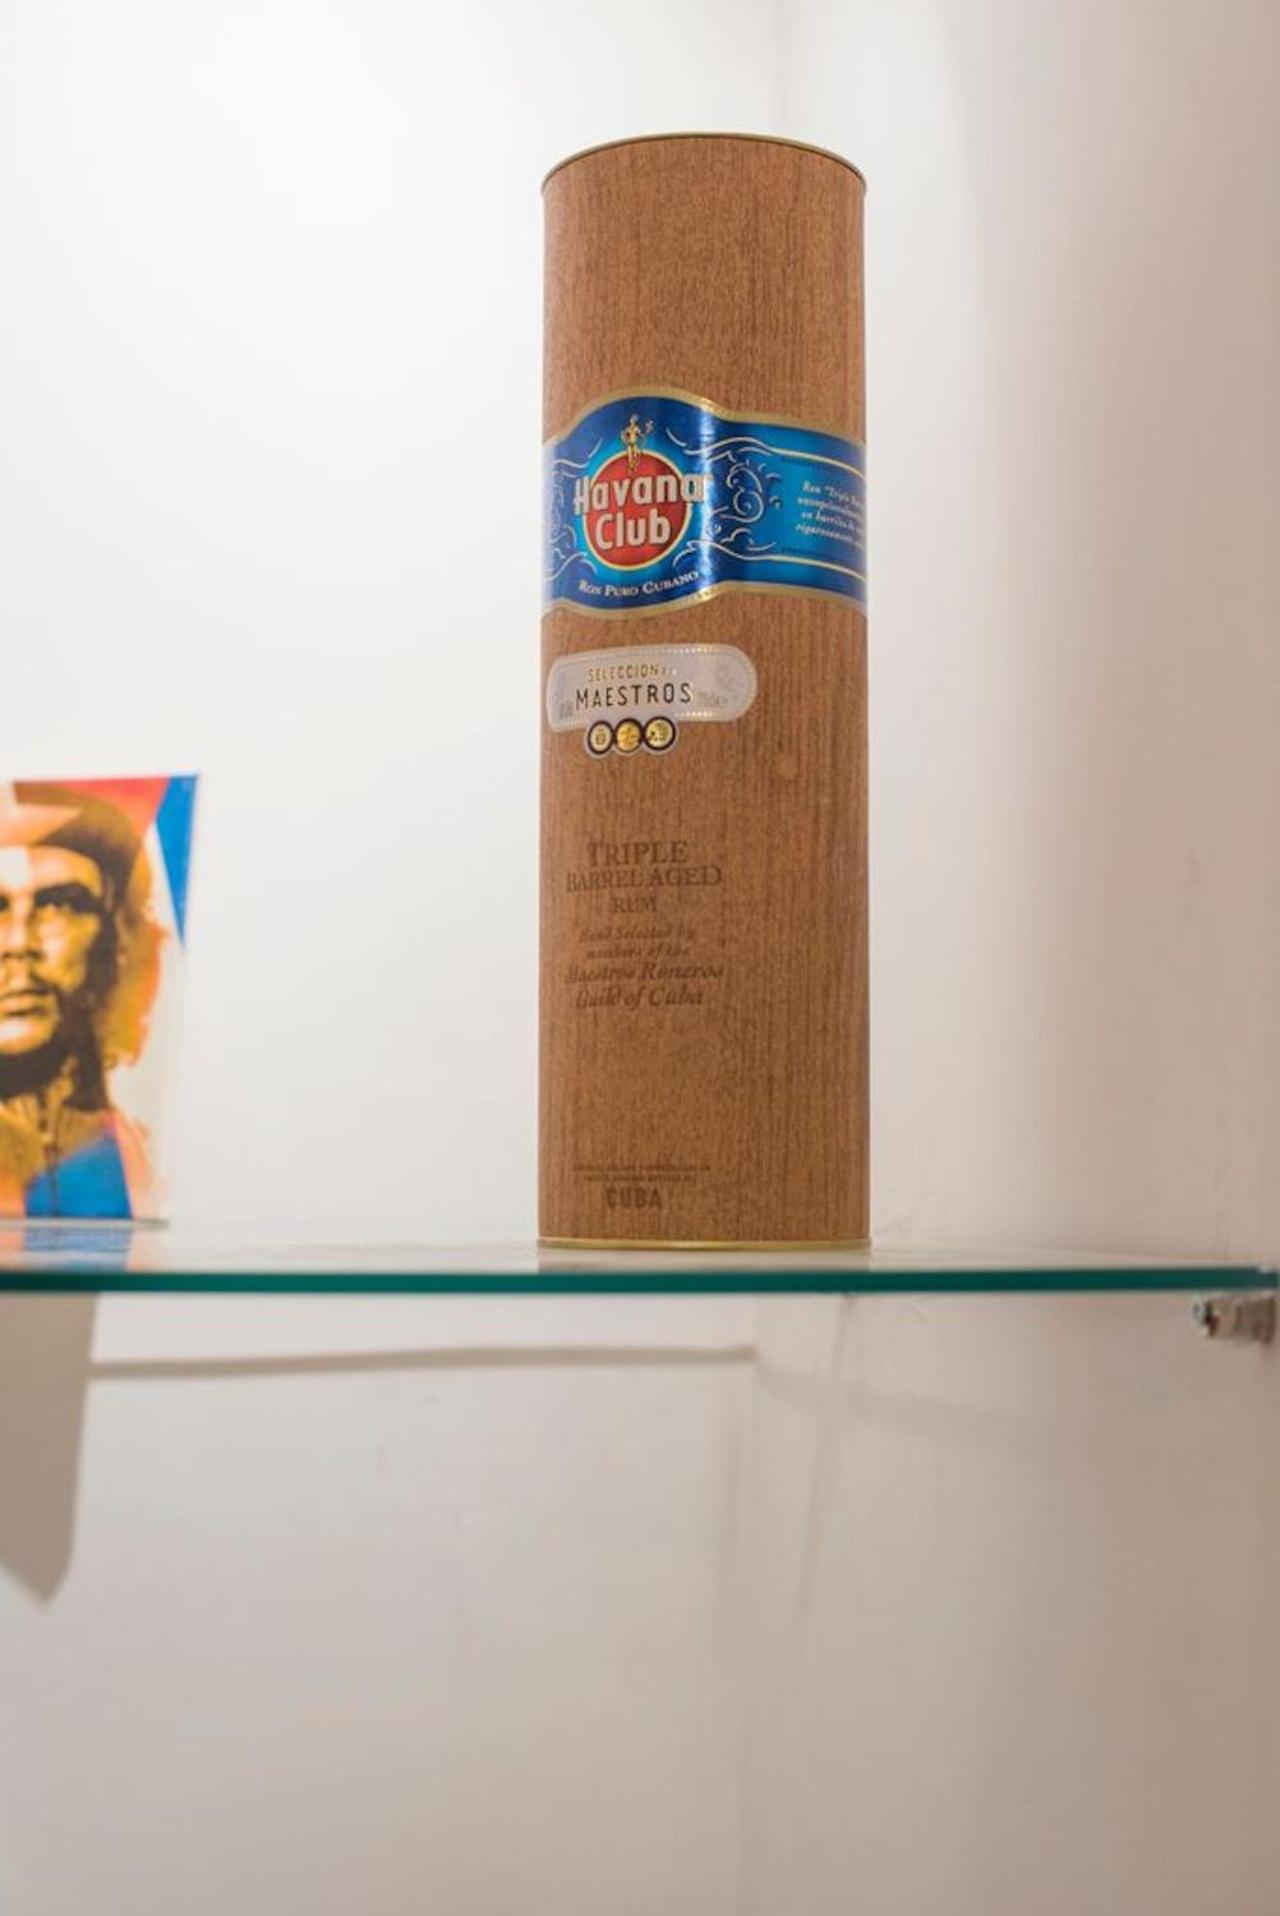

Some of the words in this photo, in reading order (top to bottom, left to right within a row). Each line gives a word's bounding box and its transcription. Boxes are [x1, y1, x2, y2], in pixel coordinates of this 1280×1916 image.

[573, 472, 712, 515] Havana
[595, 504, 672, 551] Club
[575, 682, 692, 711] MAESTROS
[586, 841, 690, 867] TRIPLE
[566, 870, 644, 893] BARREL
[648, 864, 723, 887] AGED
[612, 897, 658, 914] RUM
[648, 982, 704, 1007] Cuba
[606, 1186, 663, 1210] CUBA
